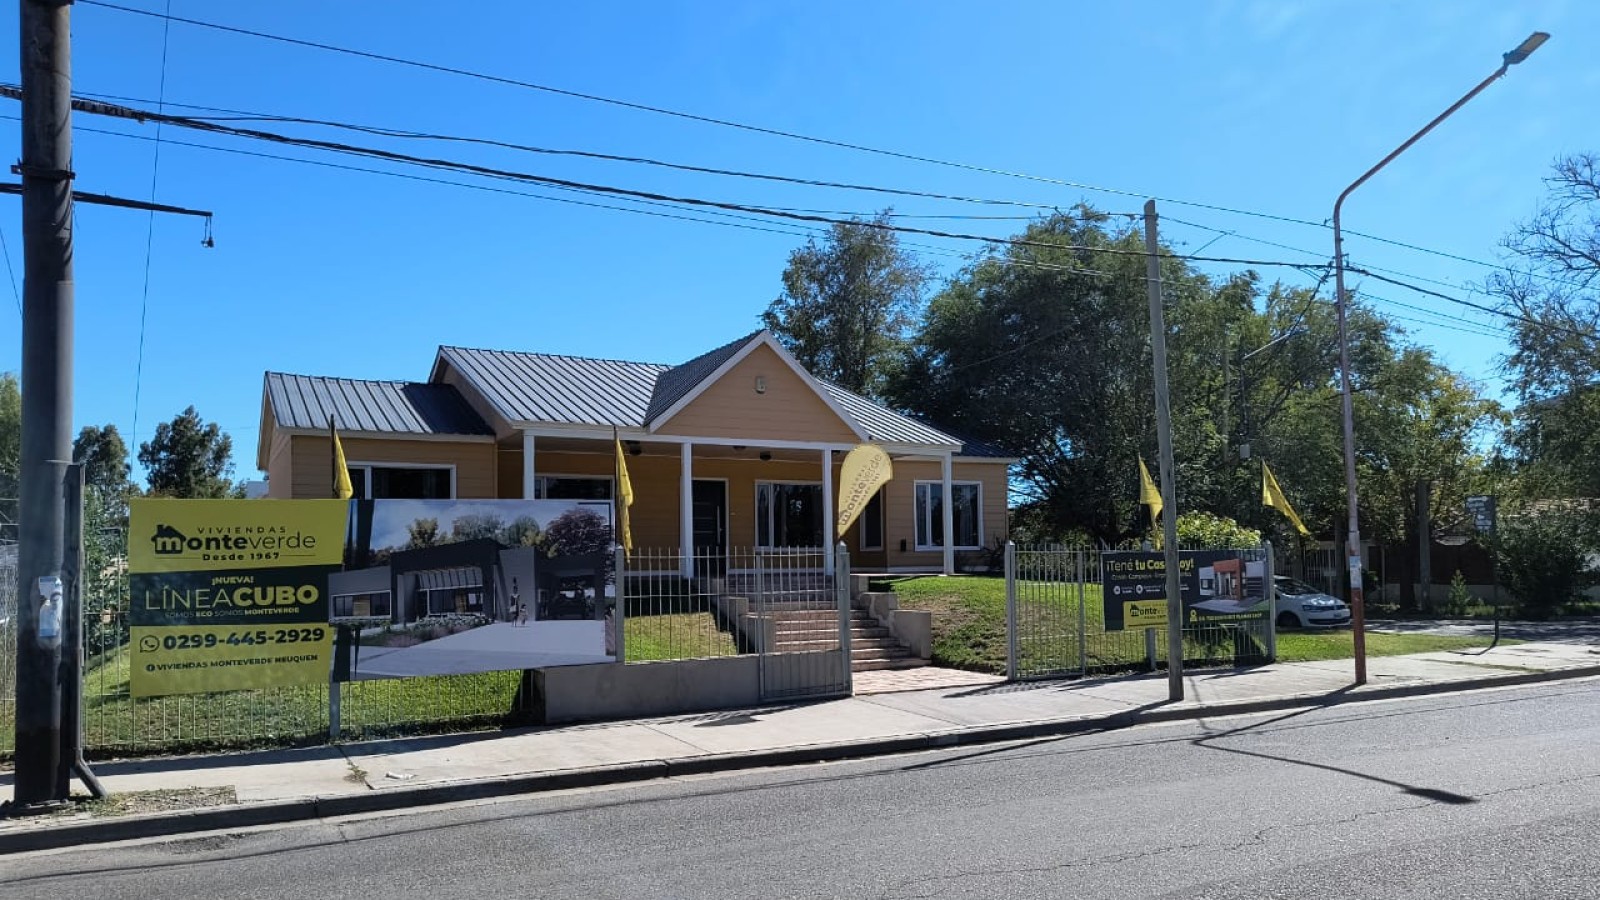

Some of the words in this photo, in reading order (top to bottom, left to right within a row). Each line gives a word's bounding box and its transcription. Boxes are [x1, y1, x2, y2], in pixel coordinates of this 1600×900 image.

[198, 526, 287, 534] VIVIENDAS
[203, 553, 244, 561] Desde
[250, 552, 280, 560] 1967
[1135, 560, 1146, 570] tu
[1147, 560, 1166, 570] Cas
[1179, 558, 1194, 571] oy!
[211, 576, 254, 586] ¡NUEVA!
[196, 610, 213, 618] ECO
[244, 607, 300, 616] MONTEVERDE
[163, 628, 325, 650] 0299-445-2929
[156, 661, 208, 671] VIVIENDAS
[210, 657, 272, 668] MONTEVERDE
